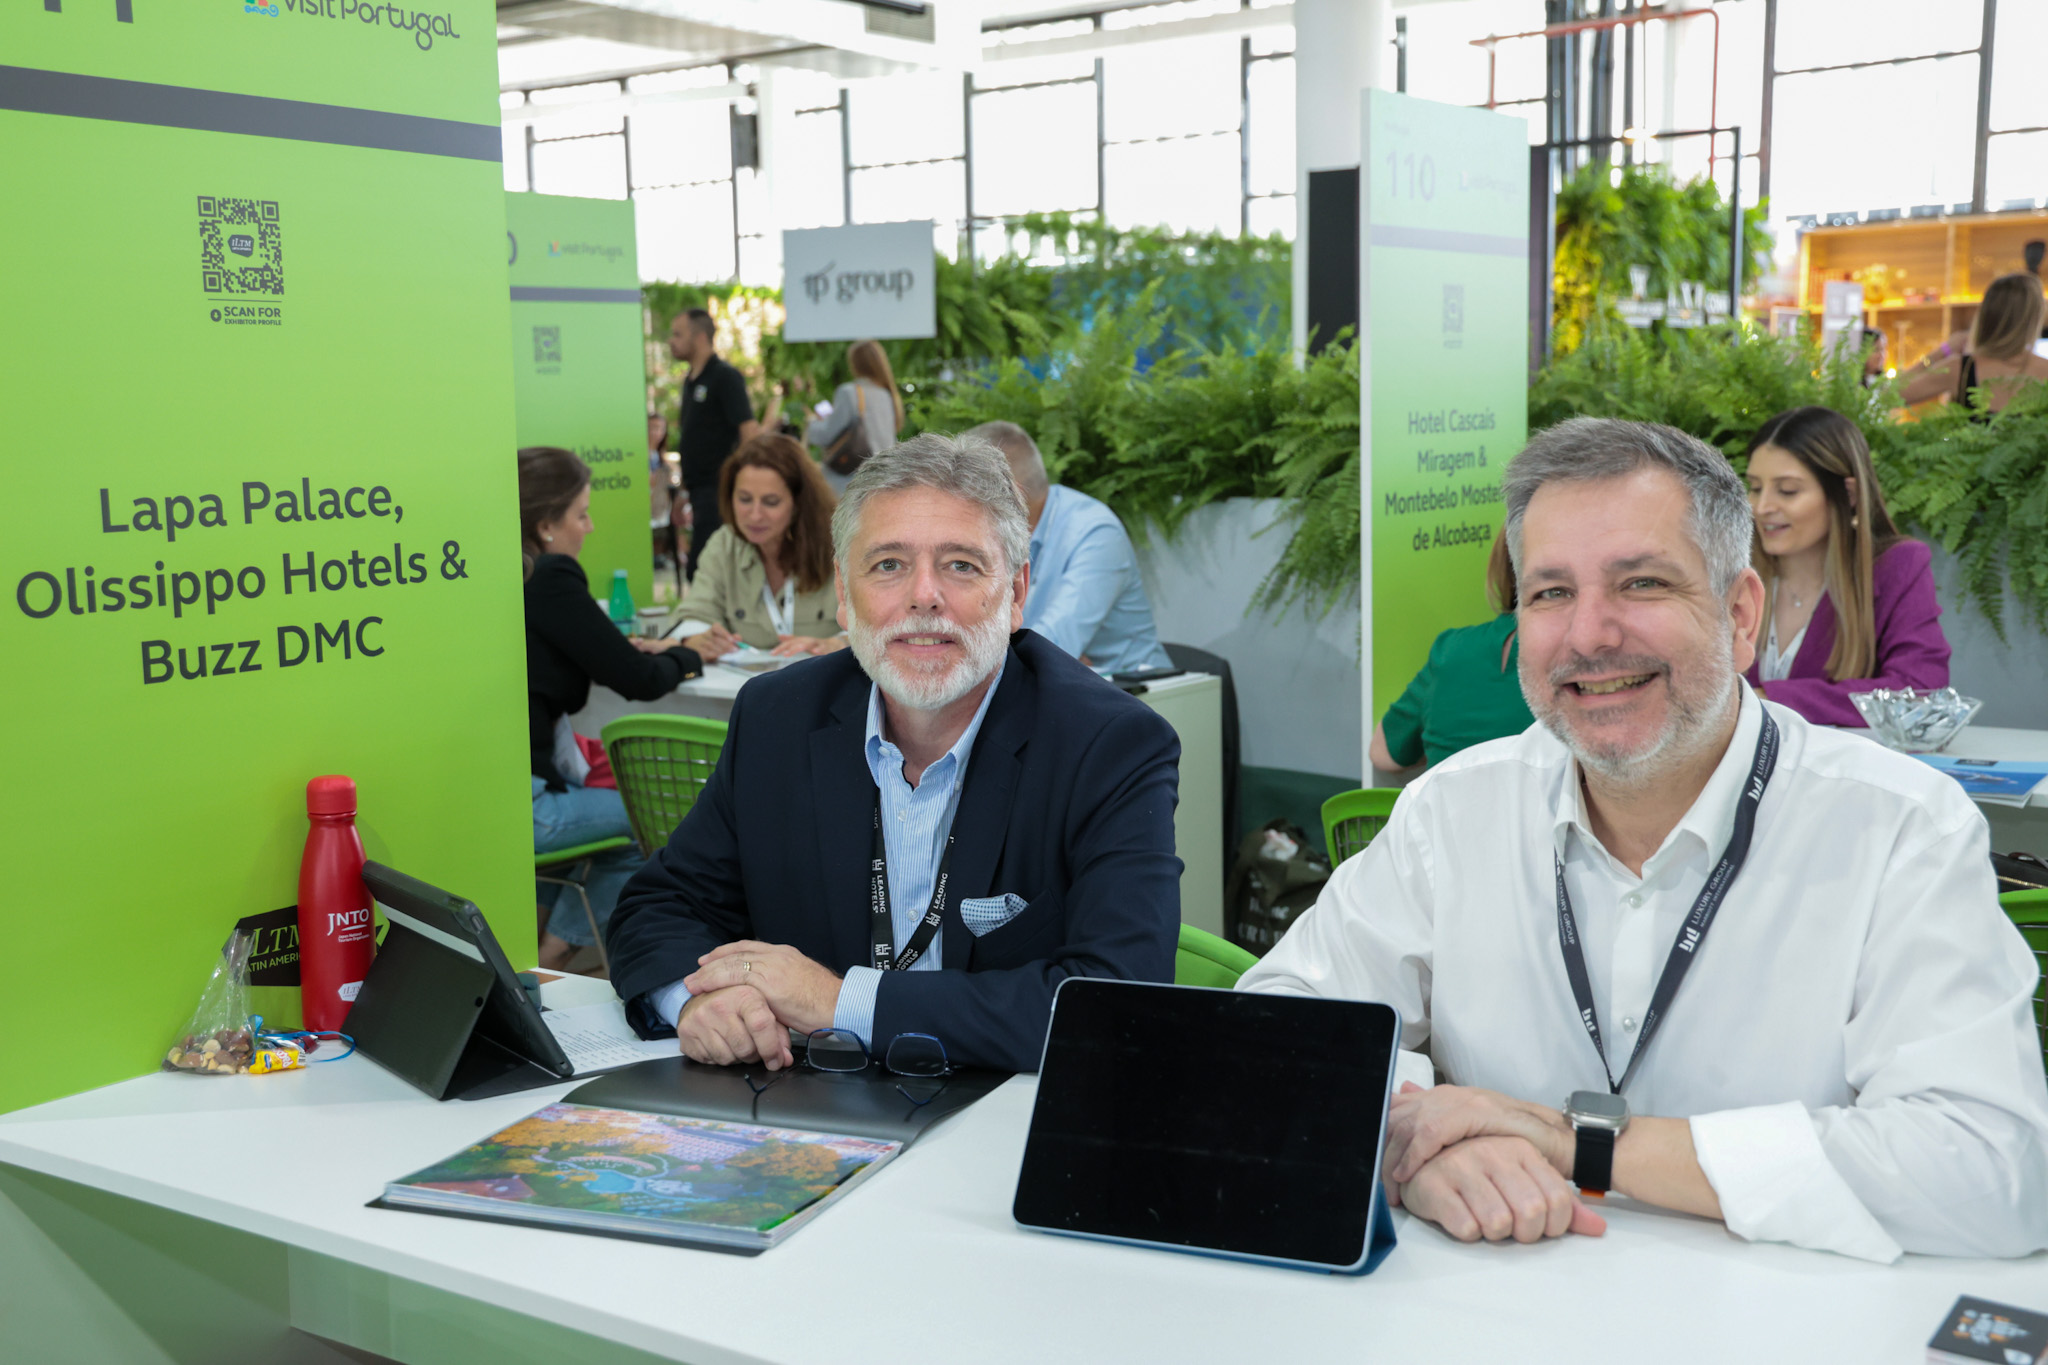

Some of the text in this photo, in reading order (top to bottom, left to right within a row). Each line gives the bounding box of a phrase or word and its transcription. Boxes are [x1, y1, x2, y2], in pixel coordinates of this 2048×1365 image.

[1386, 150, 1436, 201] 110
[837, 267, 915, 304] group
[224, 306, 281, 318] SCAN FOR
[224, 318, 257, 326] EXHIBITOR
[1408, 407, 1496, 434] Hotel Cascais
[1417, 444, 1489, 477] Miragem &
[100, 477, 404, 542] Lapa Palace,
[1385, 485, 1459, 516] Montebelo
[1413, 521, 1492, 551] de Alcobaça
[16, 540, 469, 619] Olissippo Hotels &
[141, 616, 385, 685] Buzz DMC
[1756, 745, 1769, 776] LUXURY
[877, 874, 886, 913] LEADING
[933, 872, 949, 909] LEADING
[1691, 858, 1729, 925] LUXURY GROUP
[326, 908, 370, 936] JNTO
[1563, 913, 1575, 945] GROUP
[244, 952, 300, 973] ATIN AMERI
[901, 951, 919, 971] OTELS
